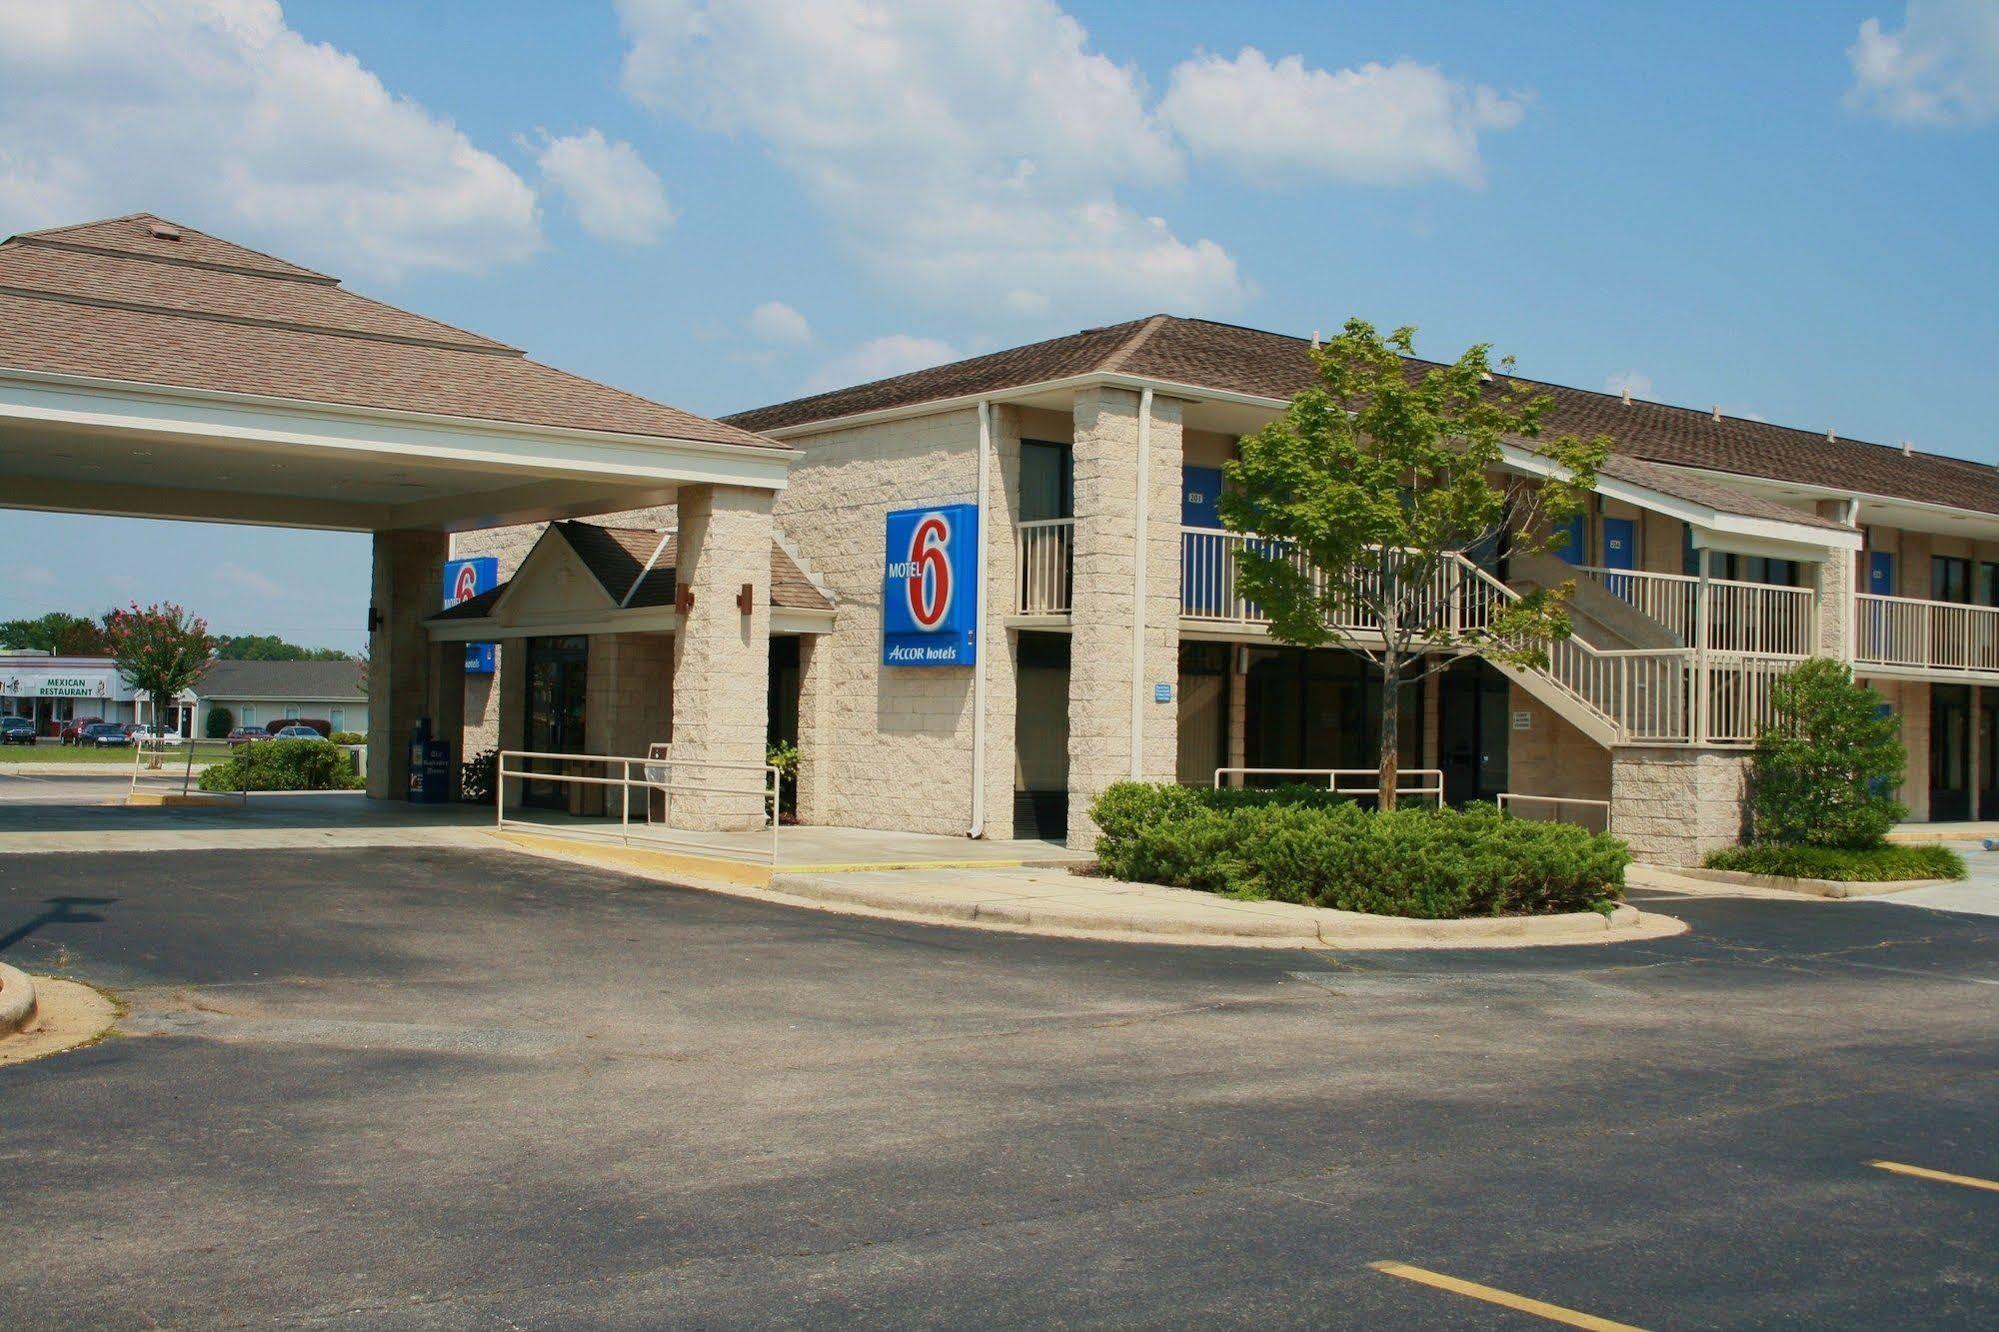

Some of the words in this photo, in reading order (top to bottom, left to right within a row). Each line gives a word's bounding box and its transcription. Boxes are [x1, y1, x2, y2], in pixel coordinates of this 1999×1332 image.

[889, 562, 922, 578] MOTEL
[908, 515, 952, 631] 6
[888, 645, 924, 660] ACCOR
[926, 646, 956, 660] hotels
[47, 679, 86, 687] MEXICAN
[40, 688, 93, 696] RESTAURANT
